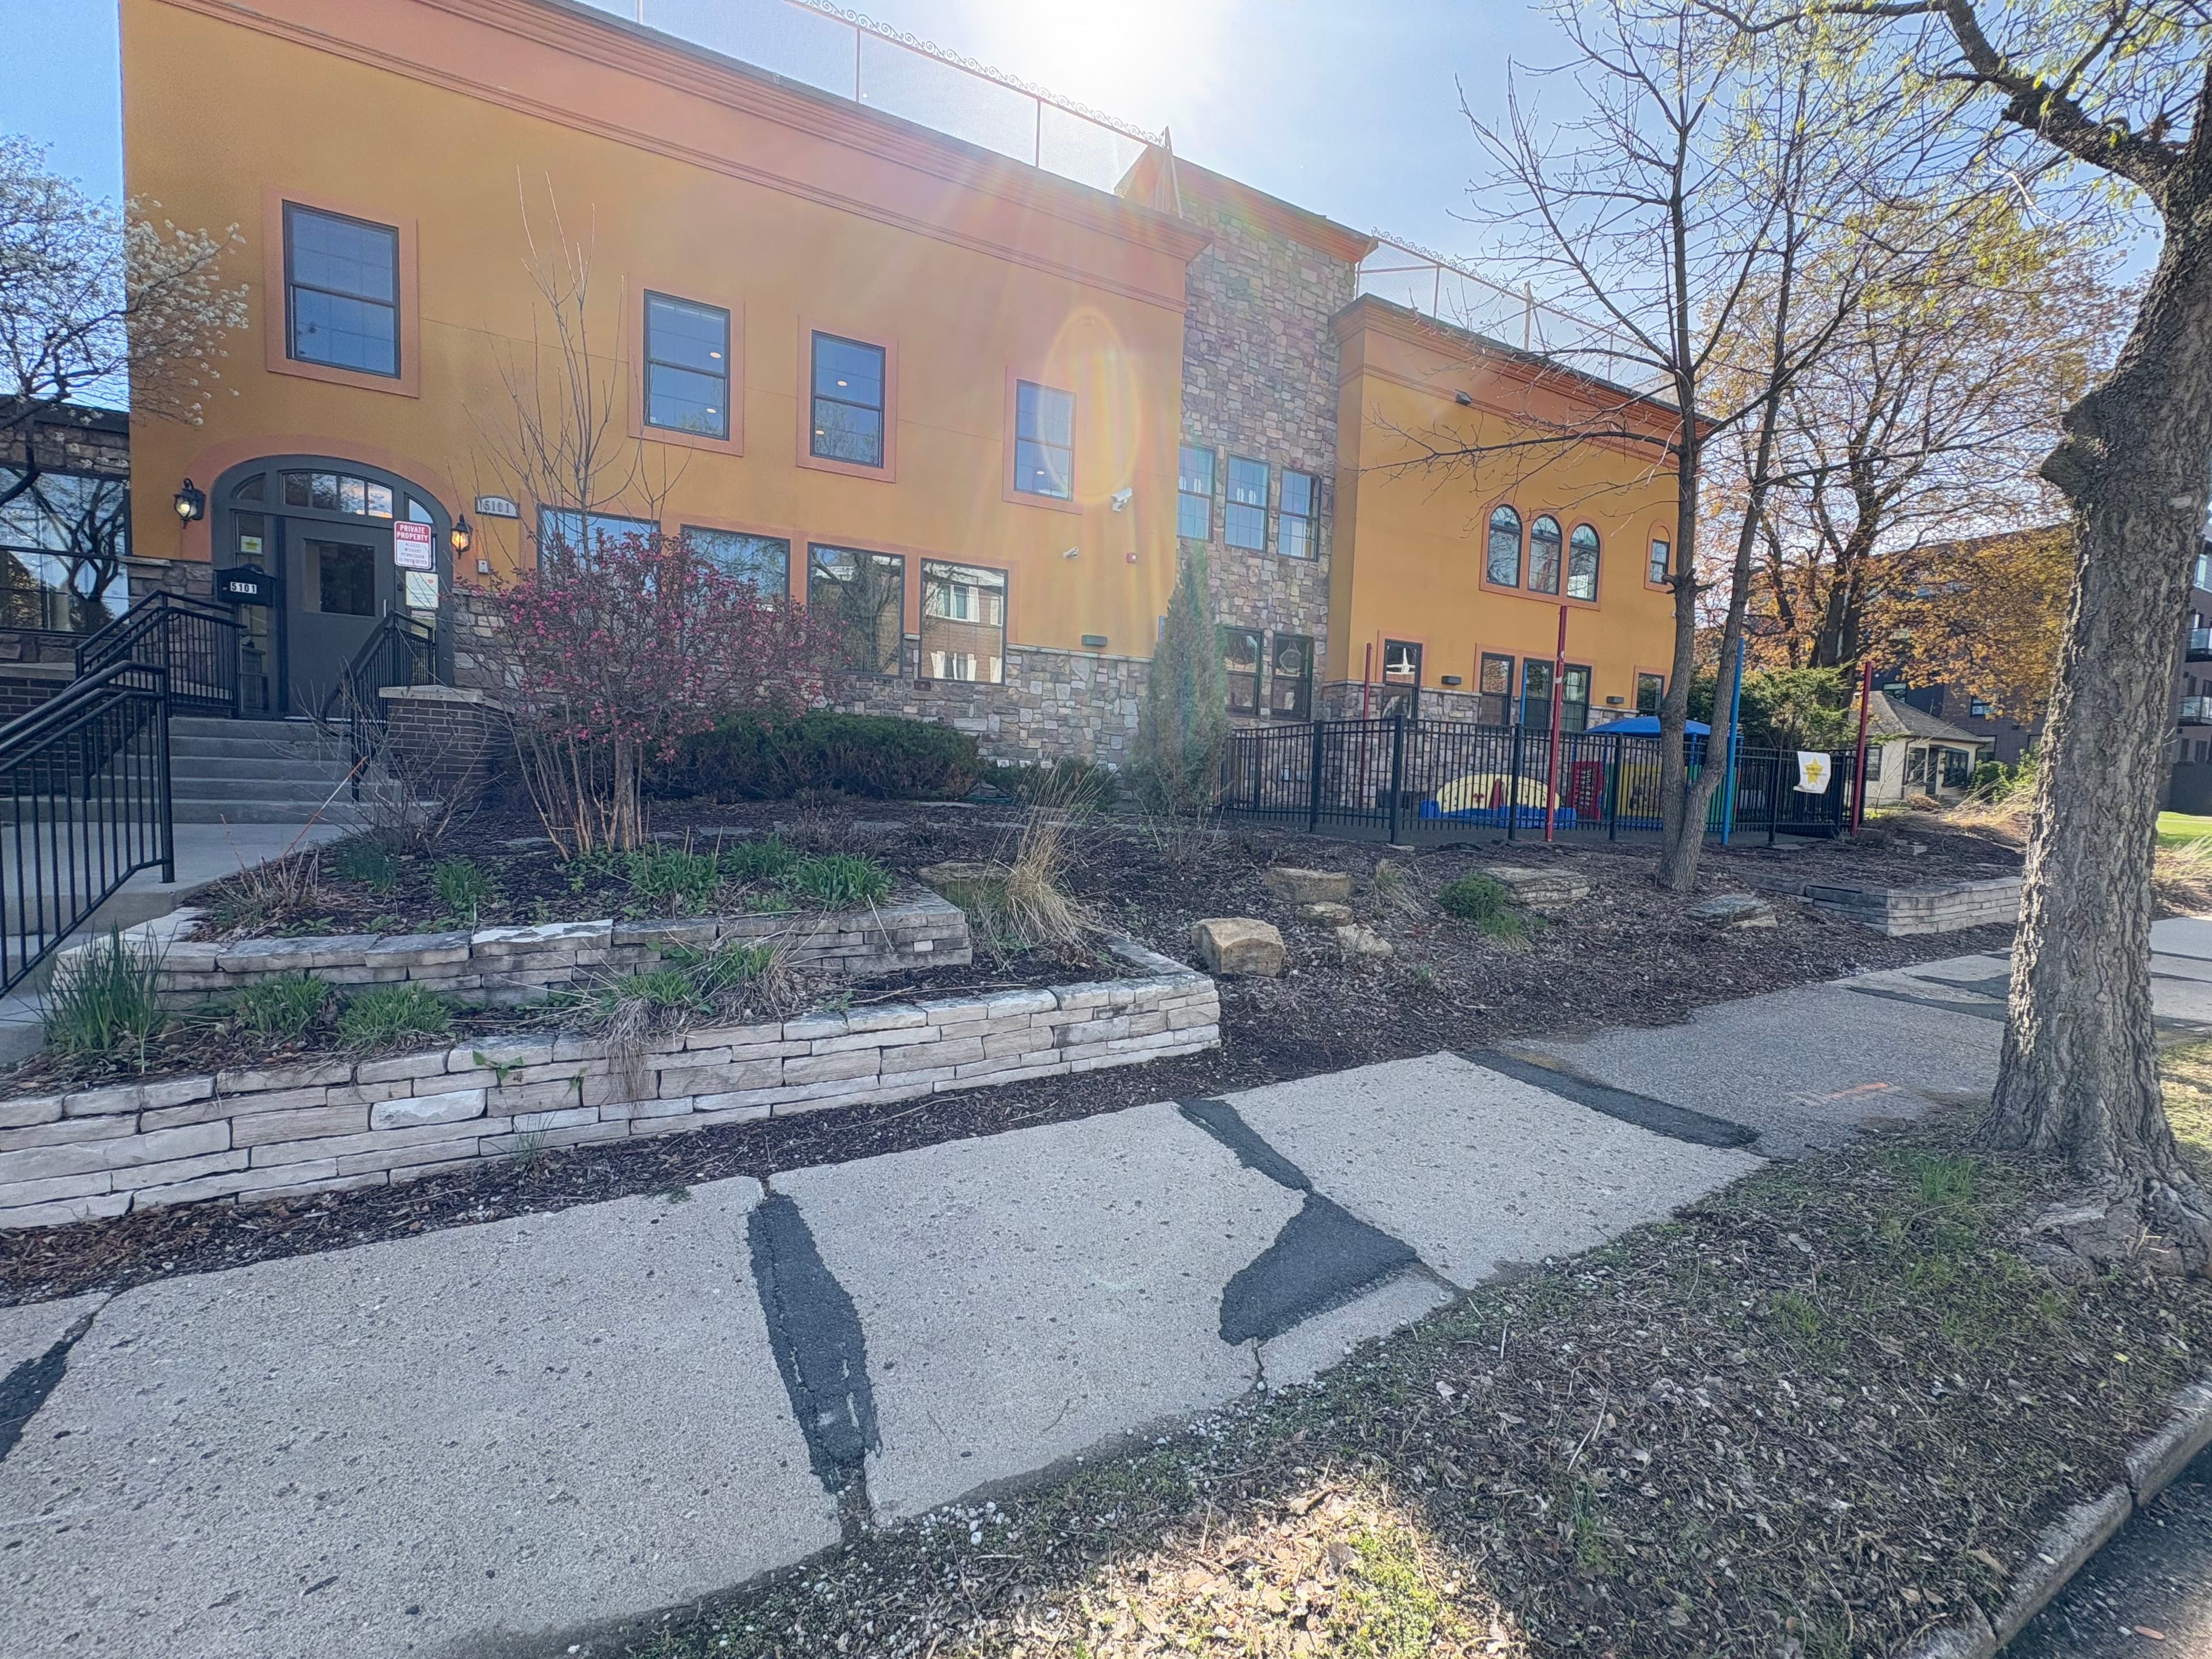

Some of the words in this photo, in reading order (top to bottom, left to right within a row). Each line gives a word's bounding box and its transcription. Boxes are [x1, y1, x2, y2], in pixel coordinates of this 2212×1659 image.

[484, 500, 509, 513] 5101
[400, 524, 425, 534] PRIVATE
[397, 531, 428, 542] PROPERTY
[232, 583, 255, 593] 5101
